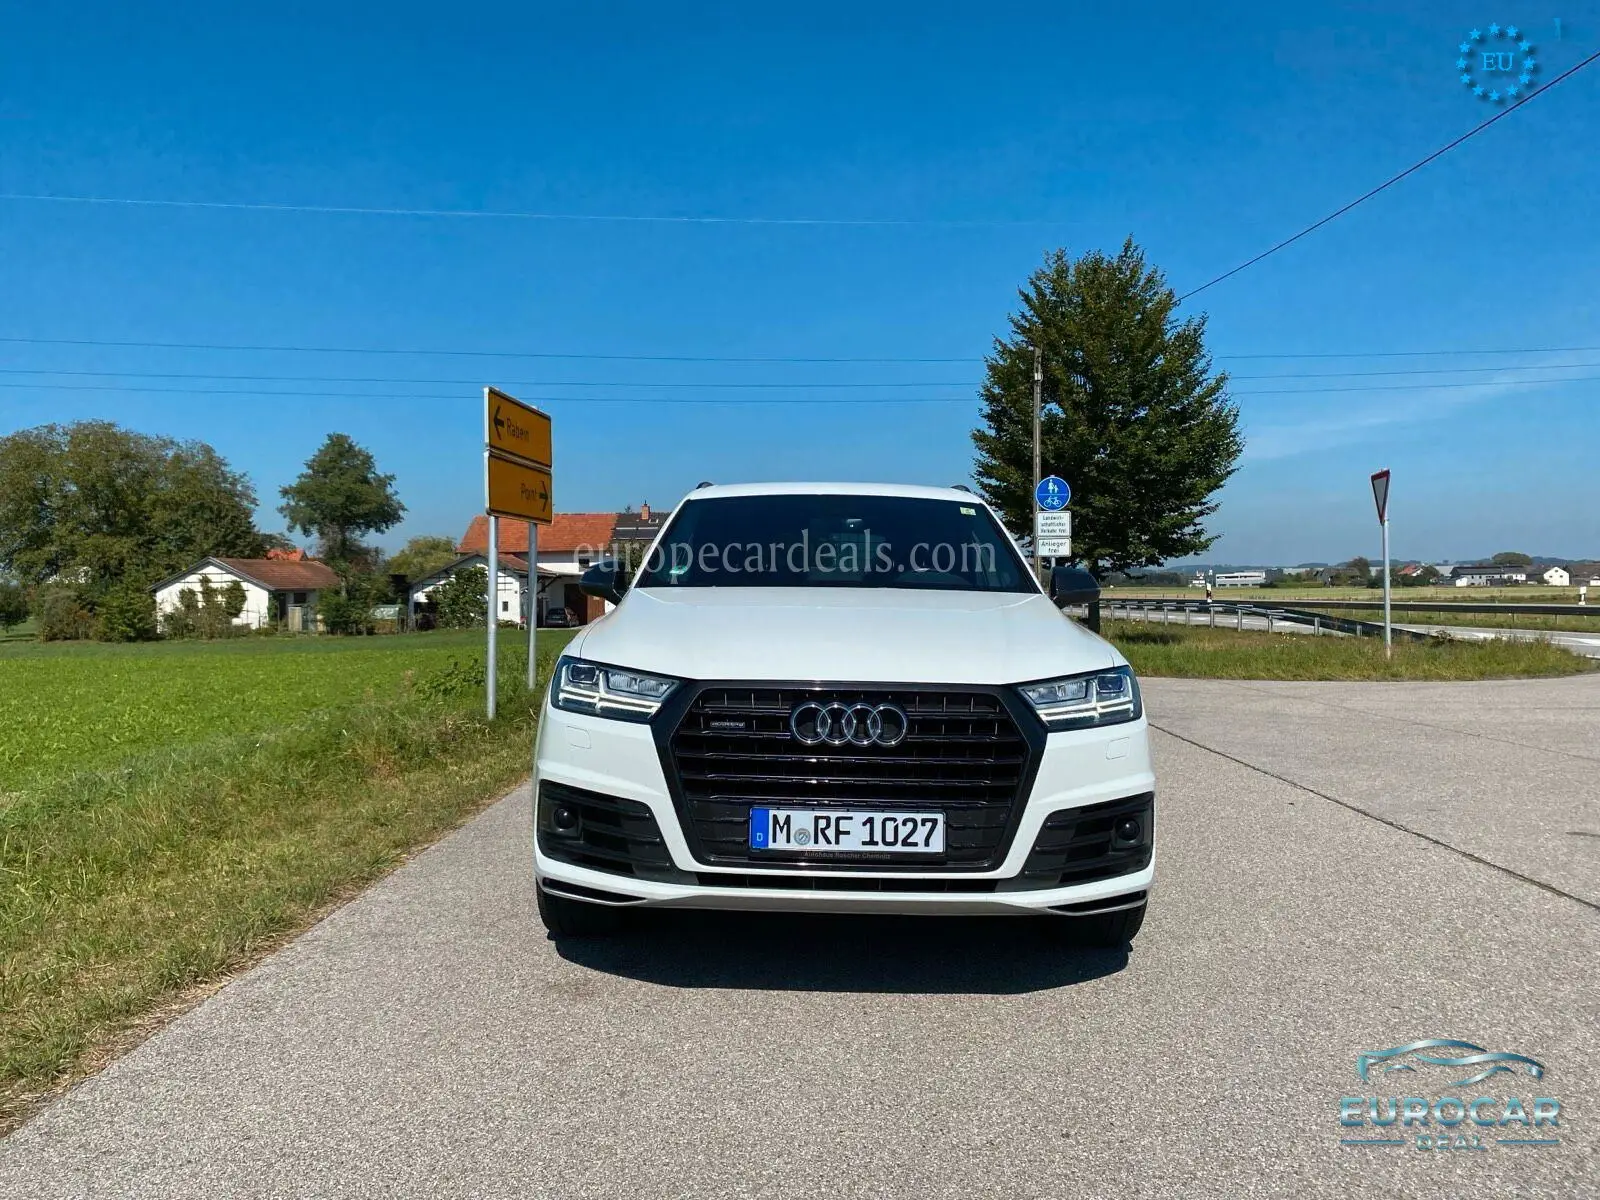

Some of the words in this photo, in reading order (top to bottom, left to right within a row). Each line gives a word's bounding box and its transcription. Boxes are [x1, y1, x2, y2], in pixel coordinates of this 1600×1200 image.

[756, 832, 763, 842] D
[771, 814, 791, 844] M
[813, 815, 853, 845] RF
[861, 816, 939, 847] 1027
